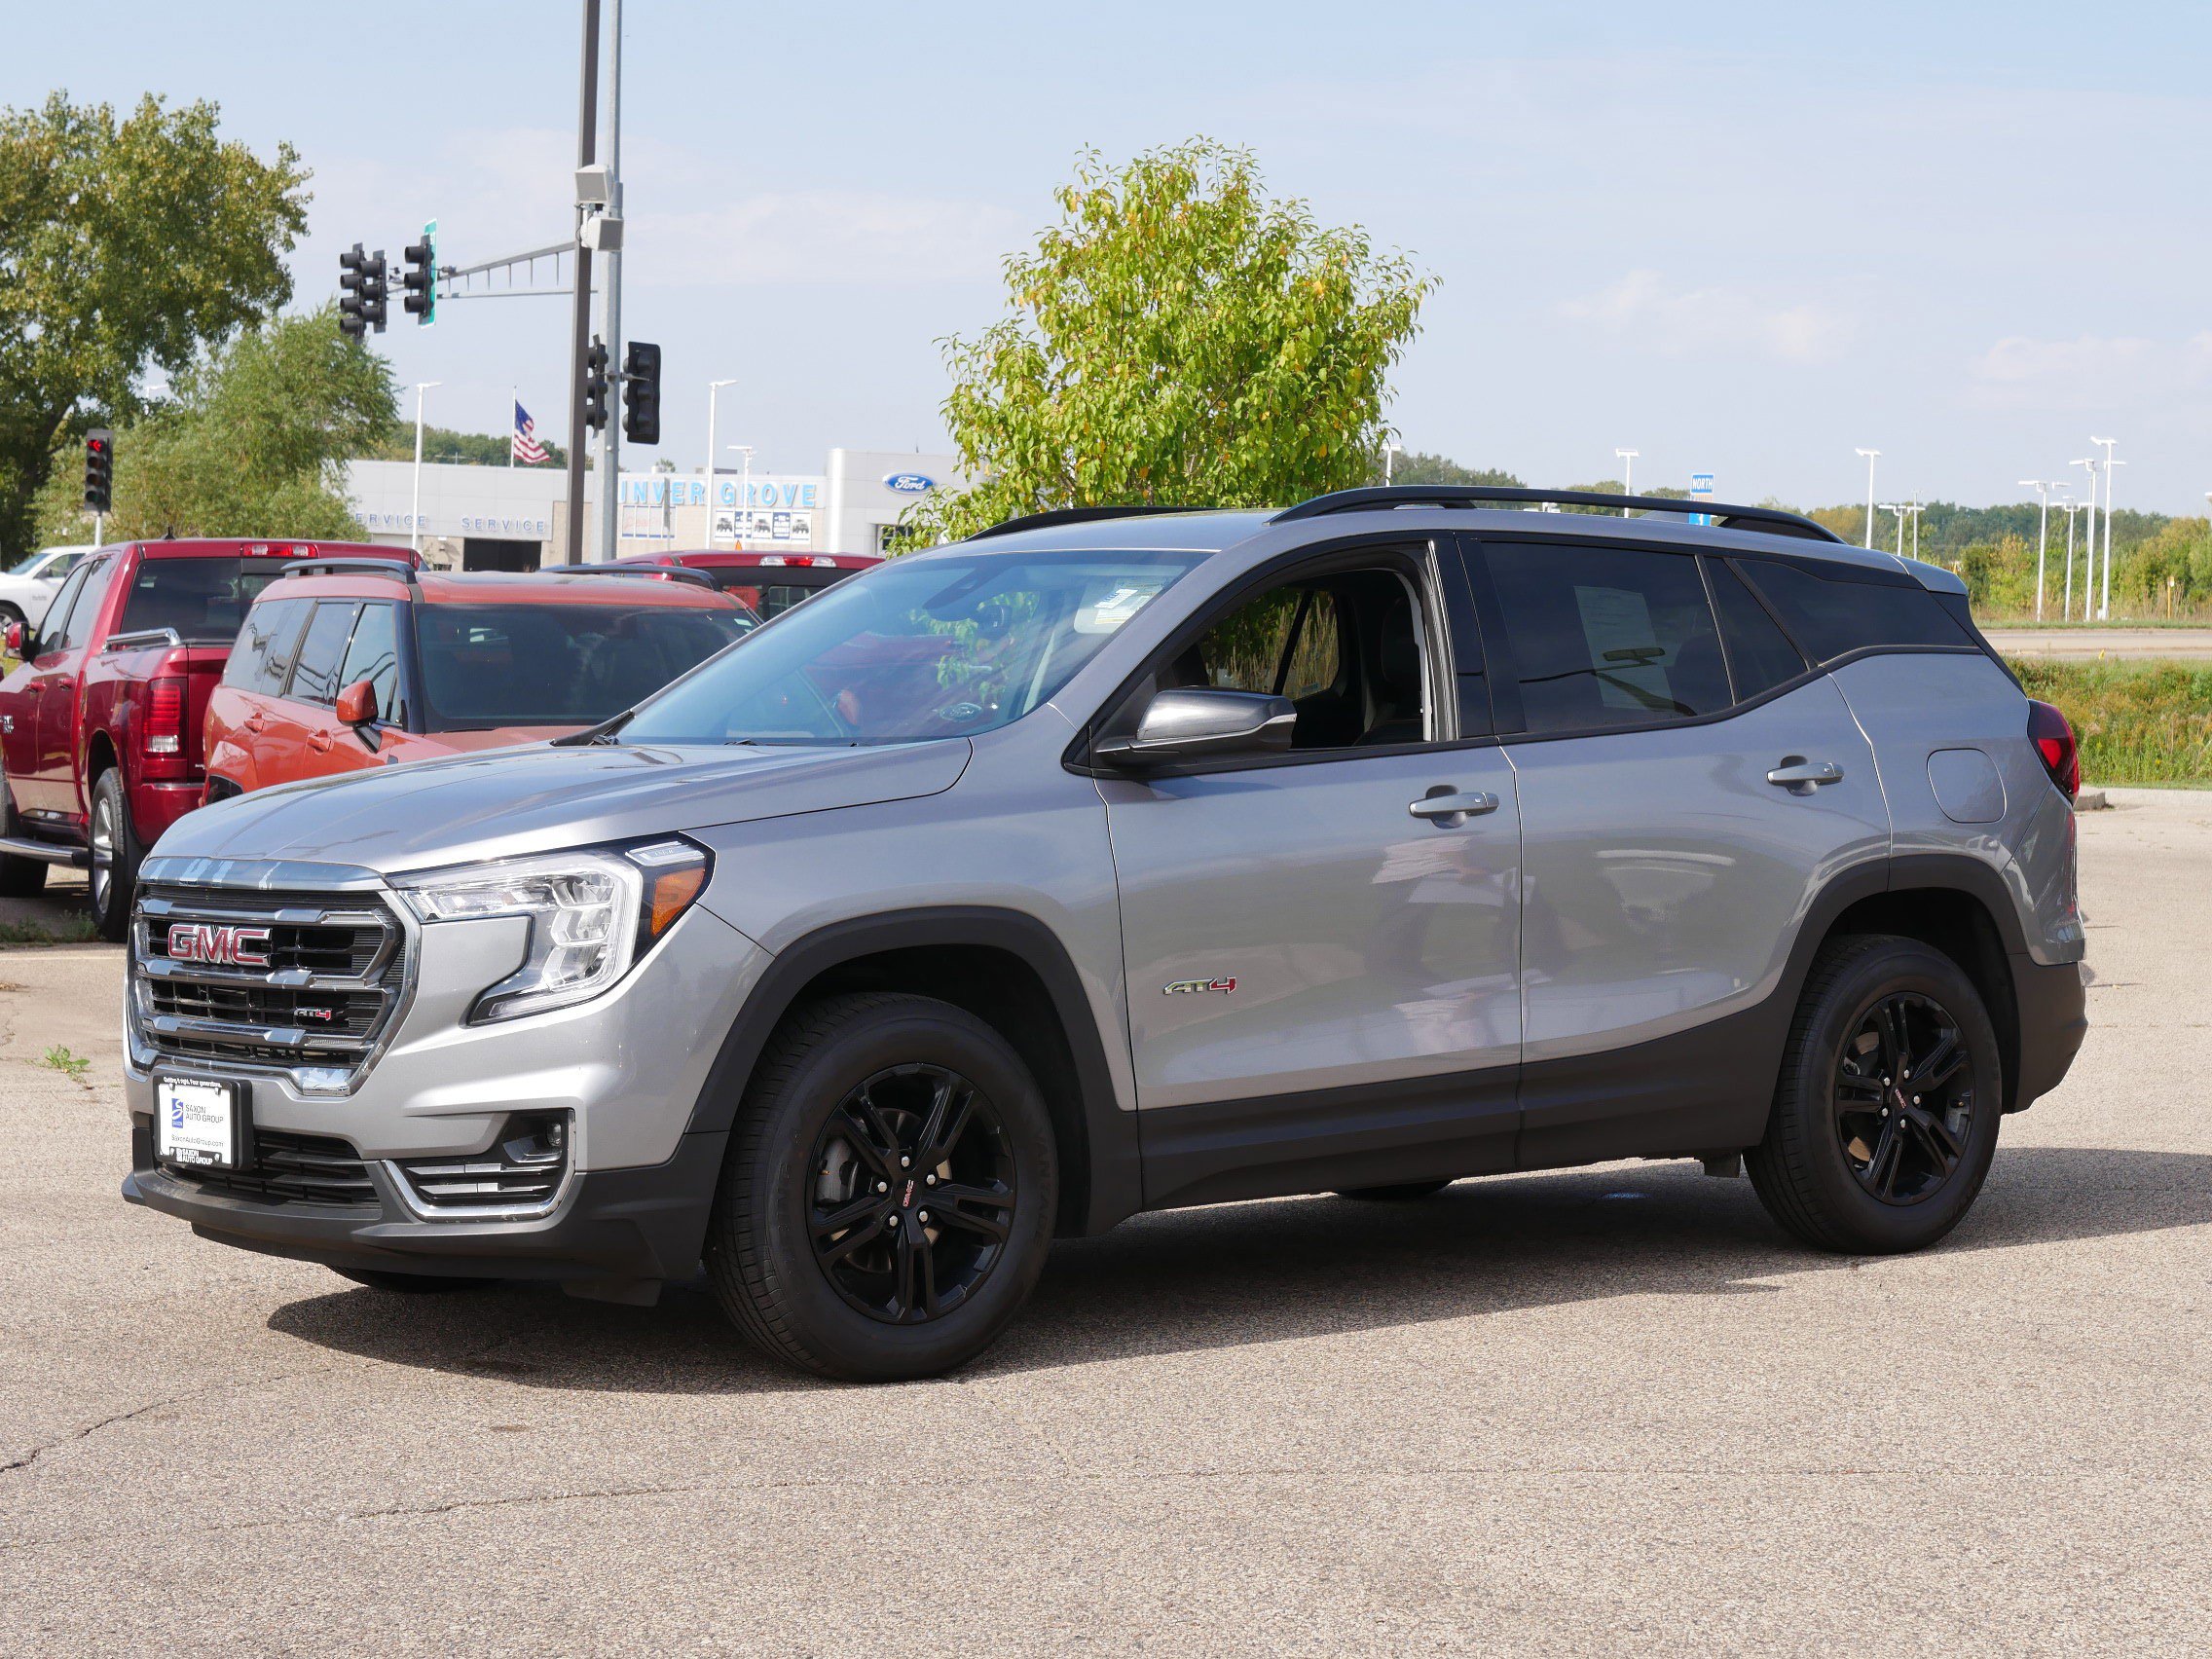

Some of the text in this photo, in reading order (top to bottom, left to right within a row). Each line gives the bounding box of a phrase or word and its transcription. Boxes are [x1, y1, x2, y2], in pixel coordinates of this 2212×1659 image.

[895, 476, 926, 490] Ford
[1692, 477, 1714, 490] NORTH
[620, 480, 817, 507] INVER GROVE
[350, 512, 426, 527] ERVICE
[461, 517, 544, 533] SERVICE
[168, 924, 272, 967] GMC
[1163, 977, 1236, 994] AT4
[294, 1008, 331, 1020] AT4
[185, 1104, 206, 1114] SAXON
[202, 1115, 224, 1124] GROUP
[183, 1155, 213, 1165] AUTO GROUP
